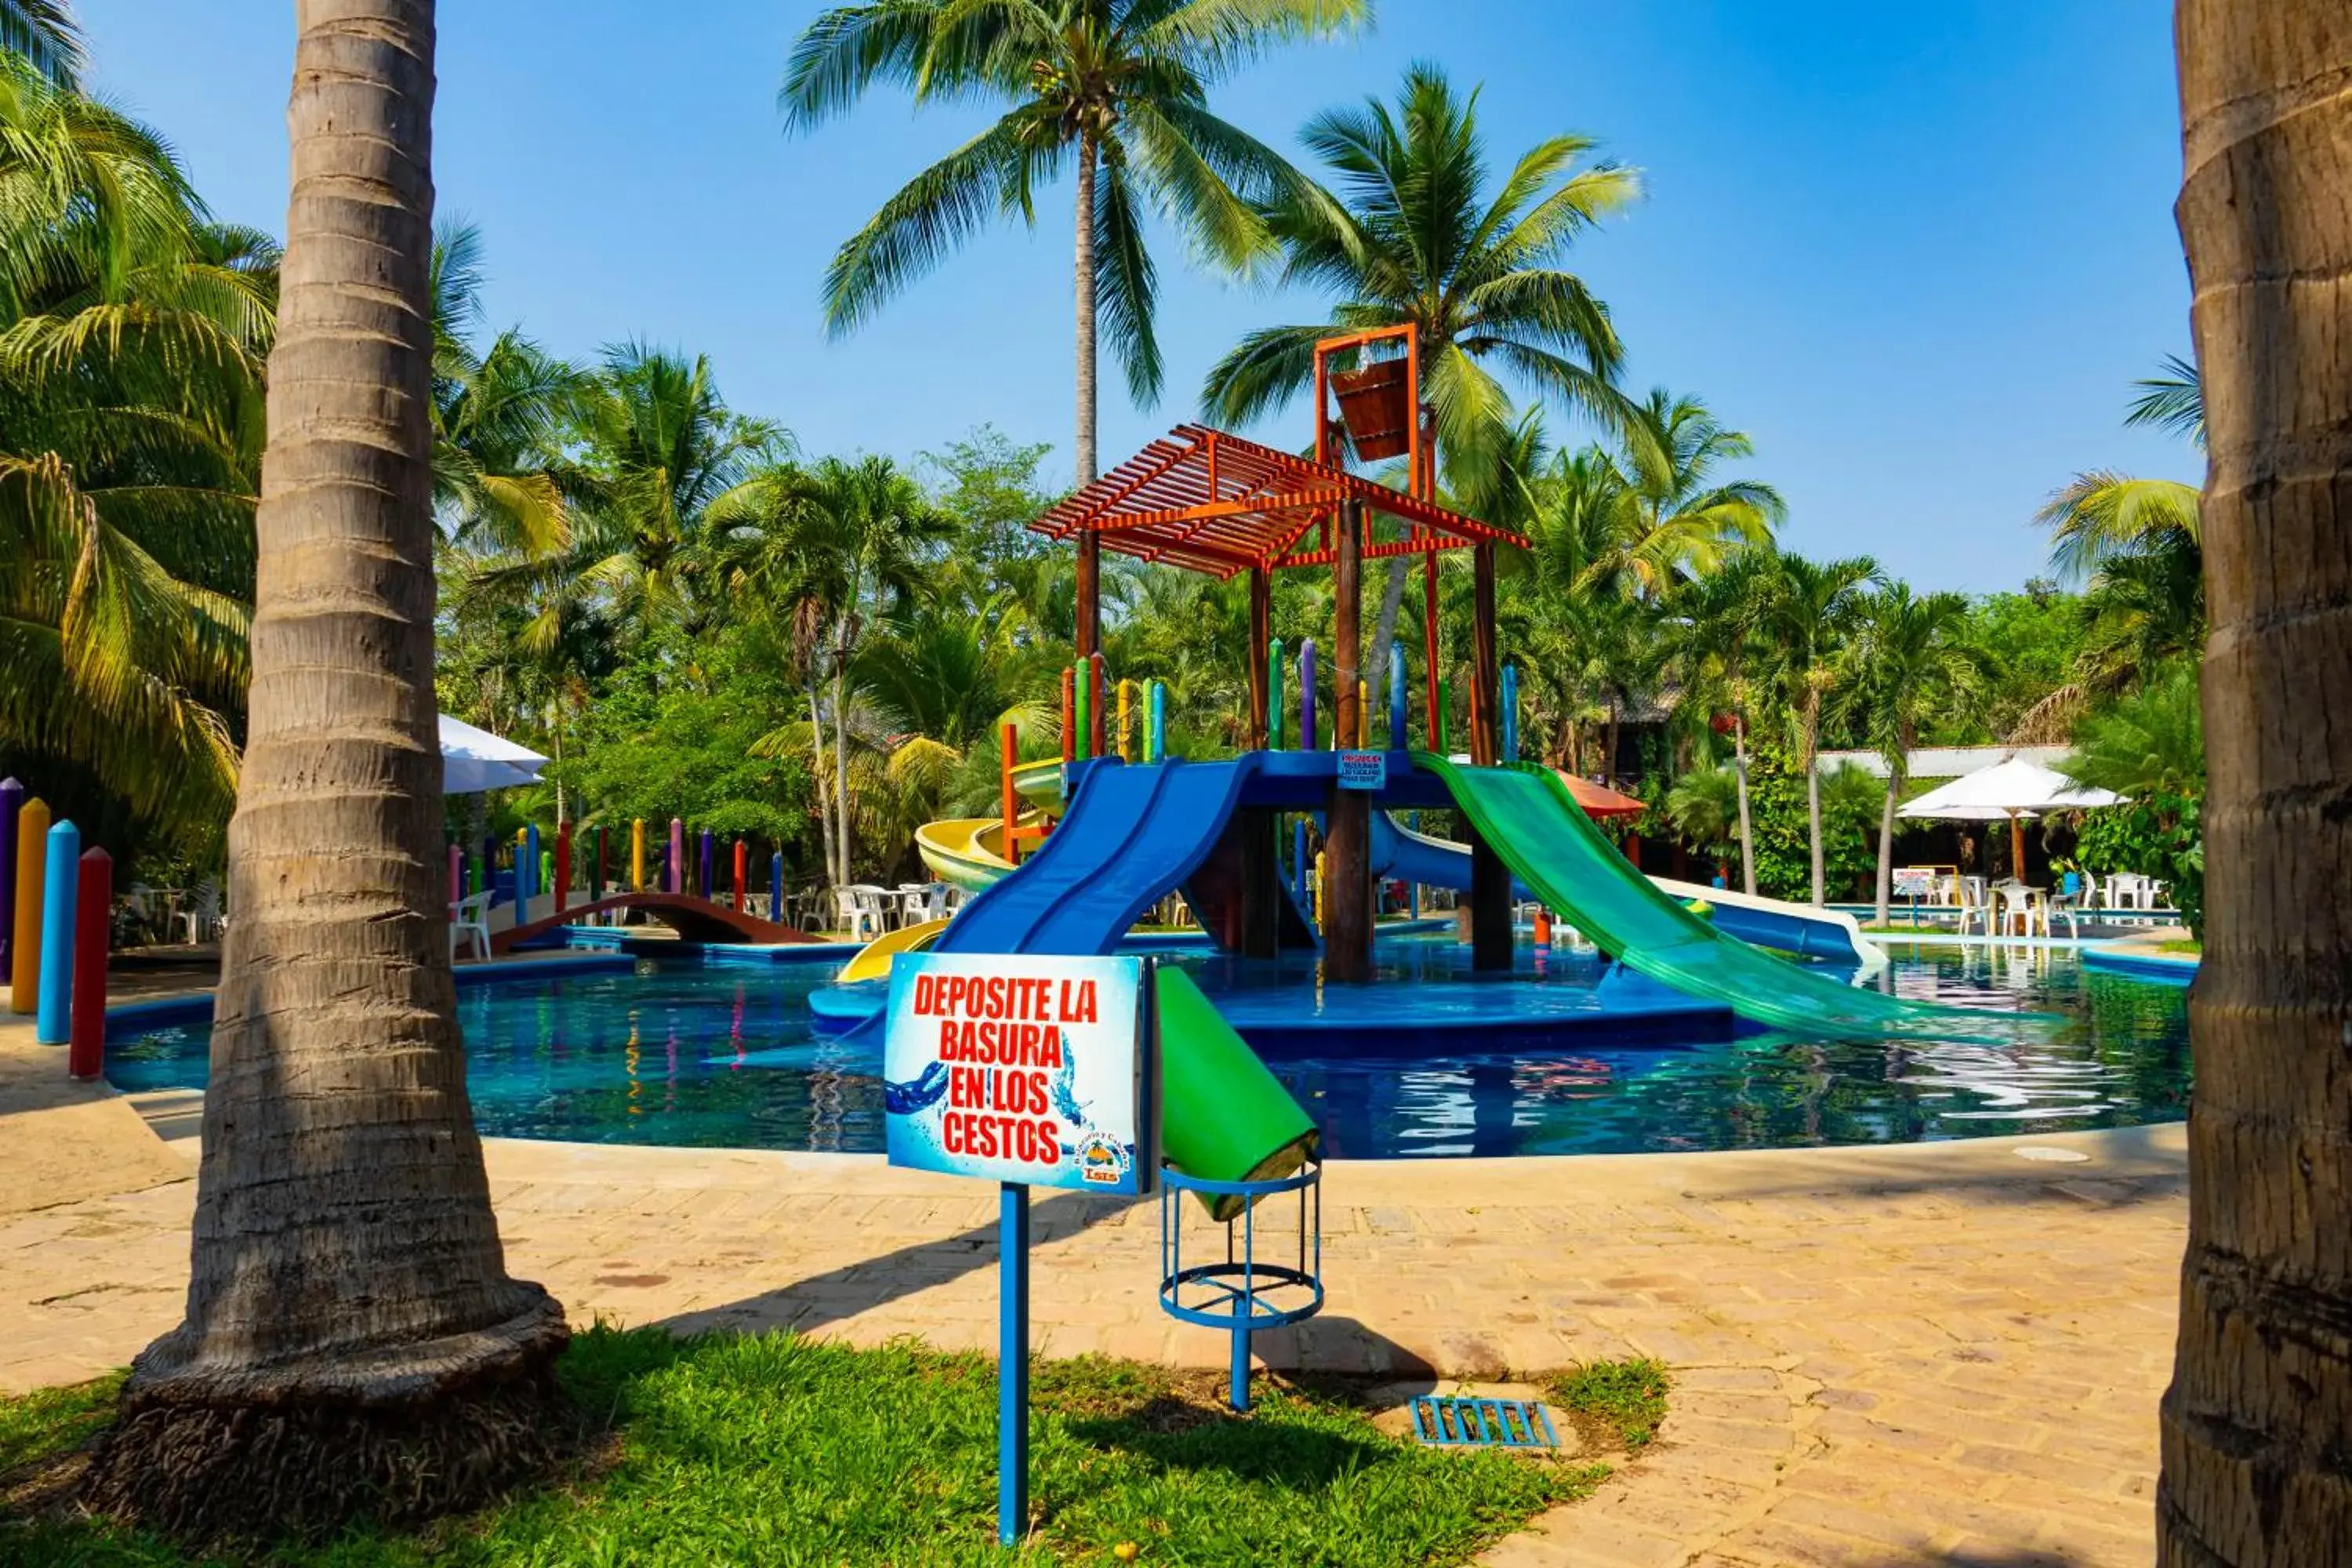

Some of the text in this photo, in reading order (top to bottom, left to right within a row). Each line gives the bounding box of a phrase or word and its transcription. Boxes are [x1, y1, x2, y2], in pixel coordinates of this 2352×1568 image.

[914, 975, 1097, 1023] DEPOSITE LA
[939, 1020, 1062, 1069] BASURA
[951, 1066, 1048, 1116] EN LOS
[944, 1112, 1059, 1164] CESTOS
